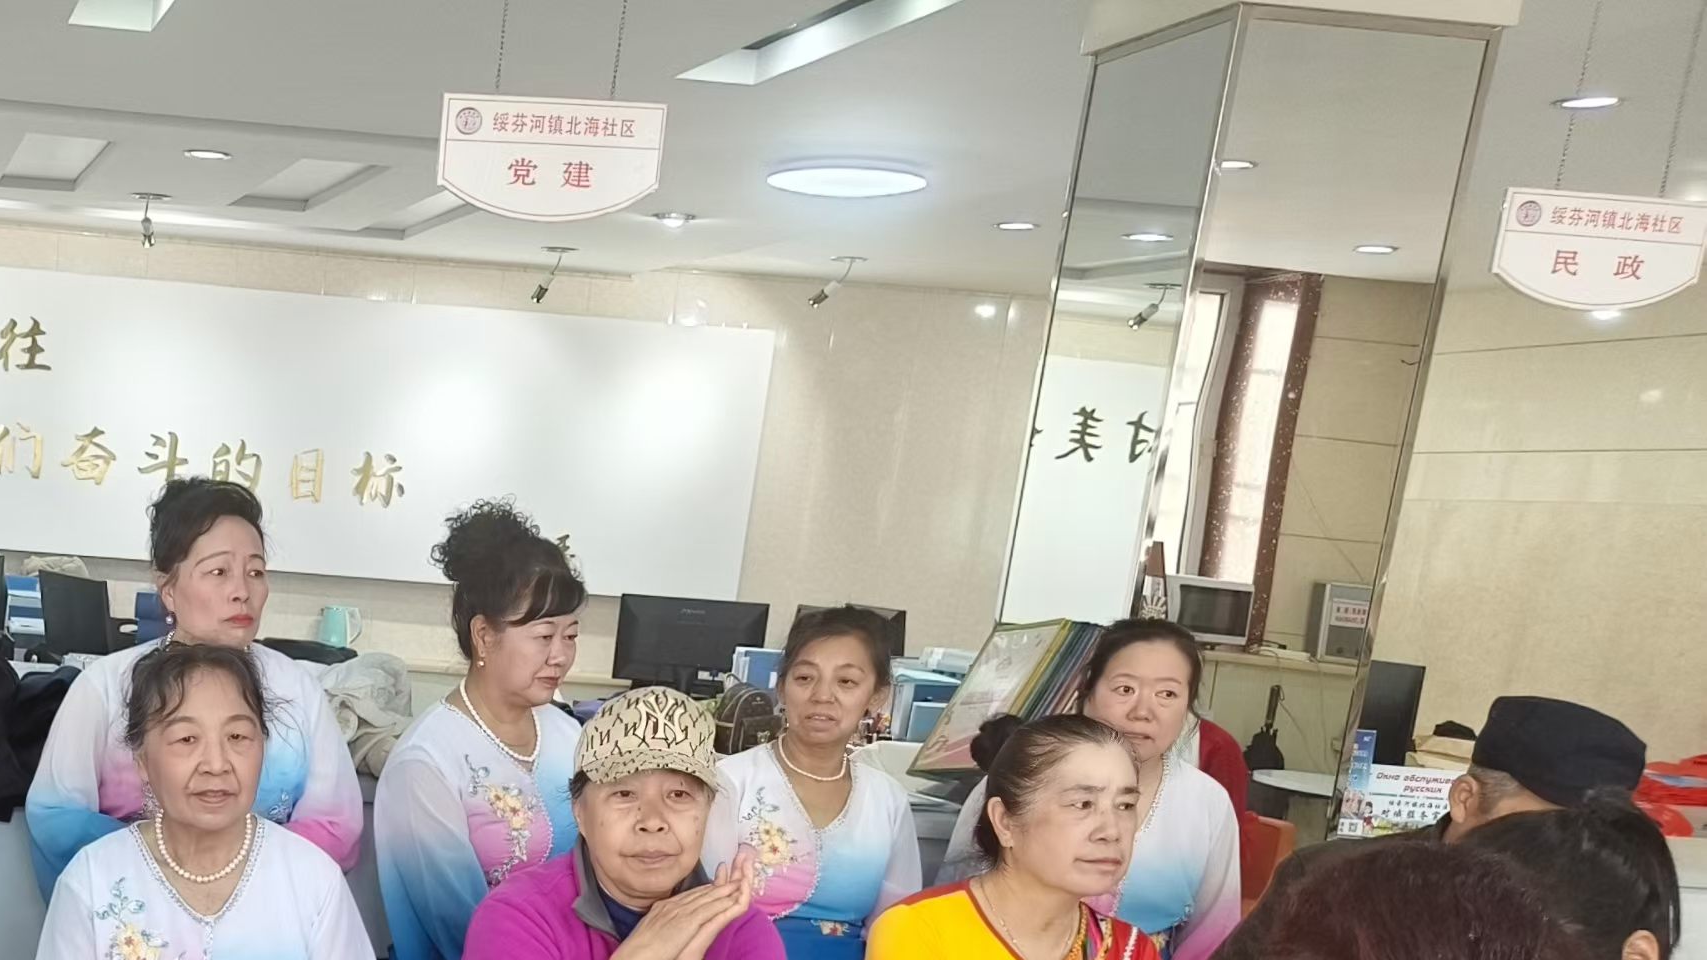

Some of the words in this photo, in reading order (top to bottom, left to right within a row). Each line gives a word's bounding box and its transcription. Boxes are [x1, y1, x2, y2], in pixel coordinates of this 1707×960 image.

[492, 111, 636, 139] 绥芬河镇北海社区
[507, 157, 594, 189] 党建
[1549, 205, 1685, 235] 绥芬河镇北海社区
[1550, 249, 1645, 281] 民政
